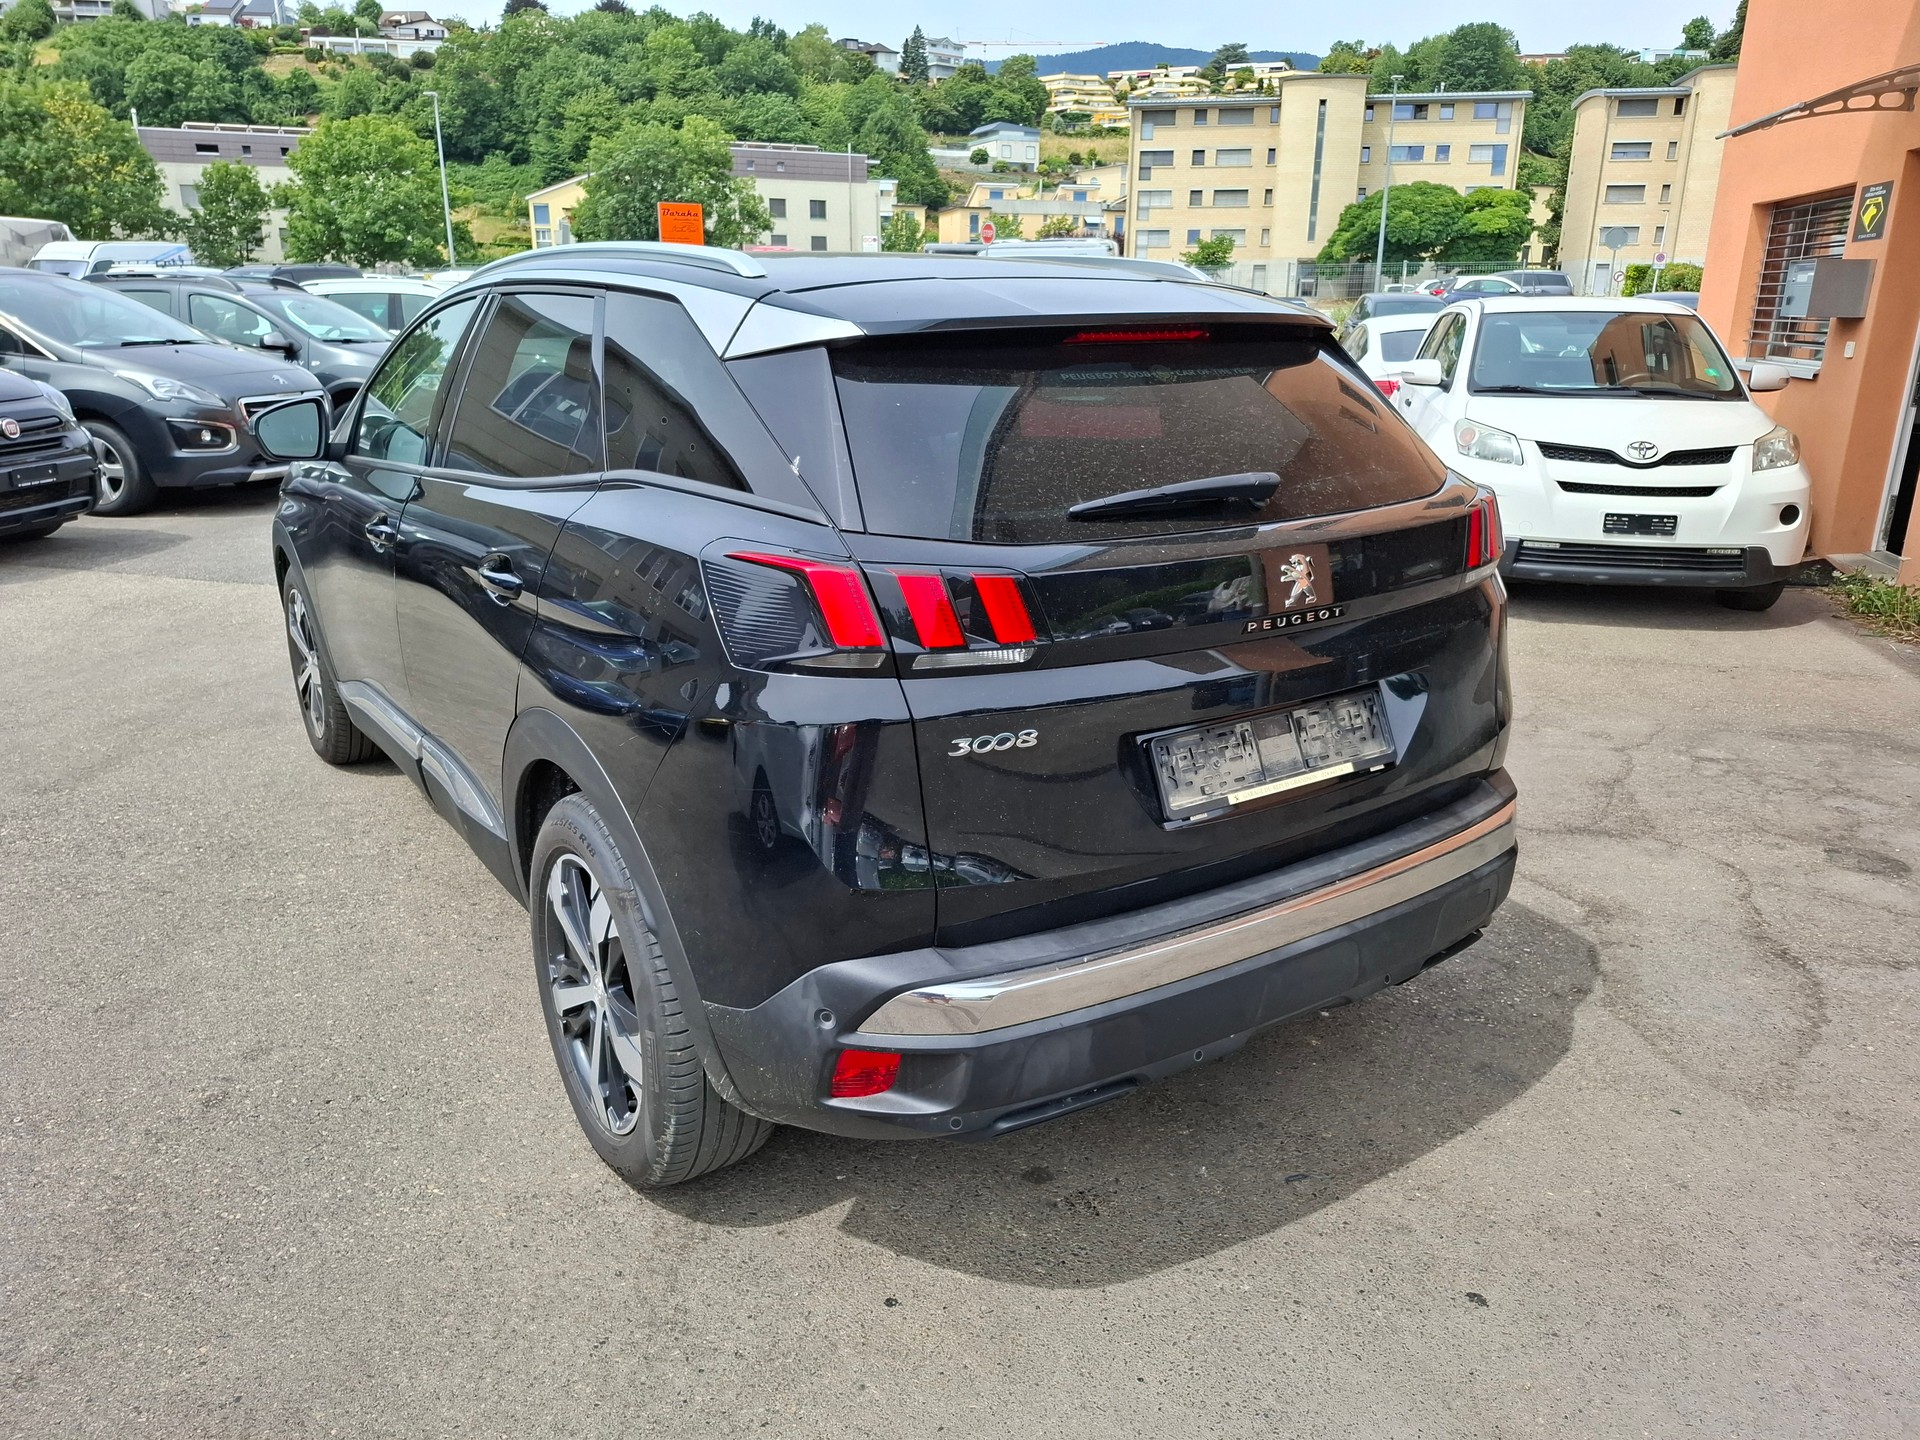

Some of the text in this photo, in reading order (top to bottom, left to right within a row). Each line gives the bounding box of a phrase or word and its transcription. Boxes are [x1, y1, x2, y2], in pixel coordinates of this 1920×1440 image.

[661, 208, 699, 217] Baraka
[1060, 372, 1119, 381] PEUGEOT
[1247, 607, 1342, 632] PEUGEOT
[947, 729, 1038, 757] 3008
